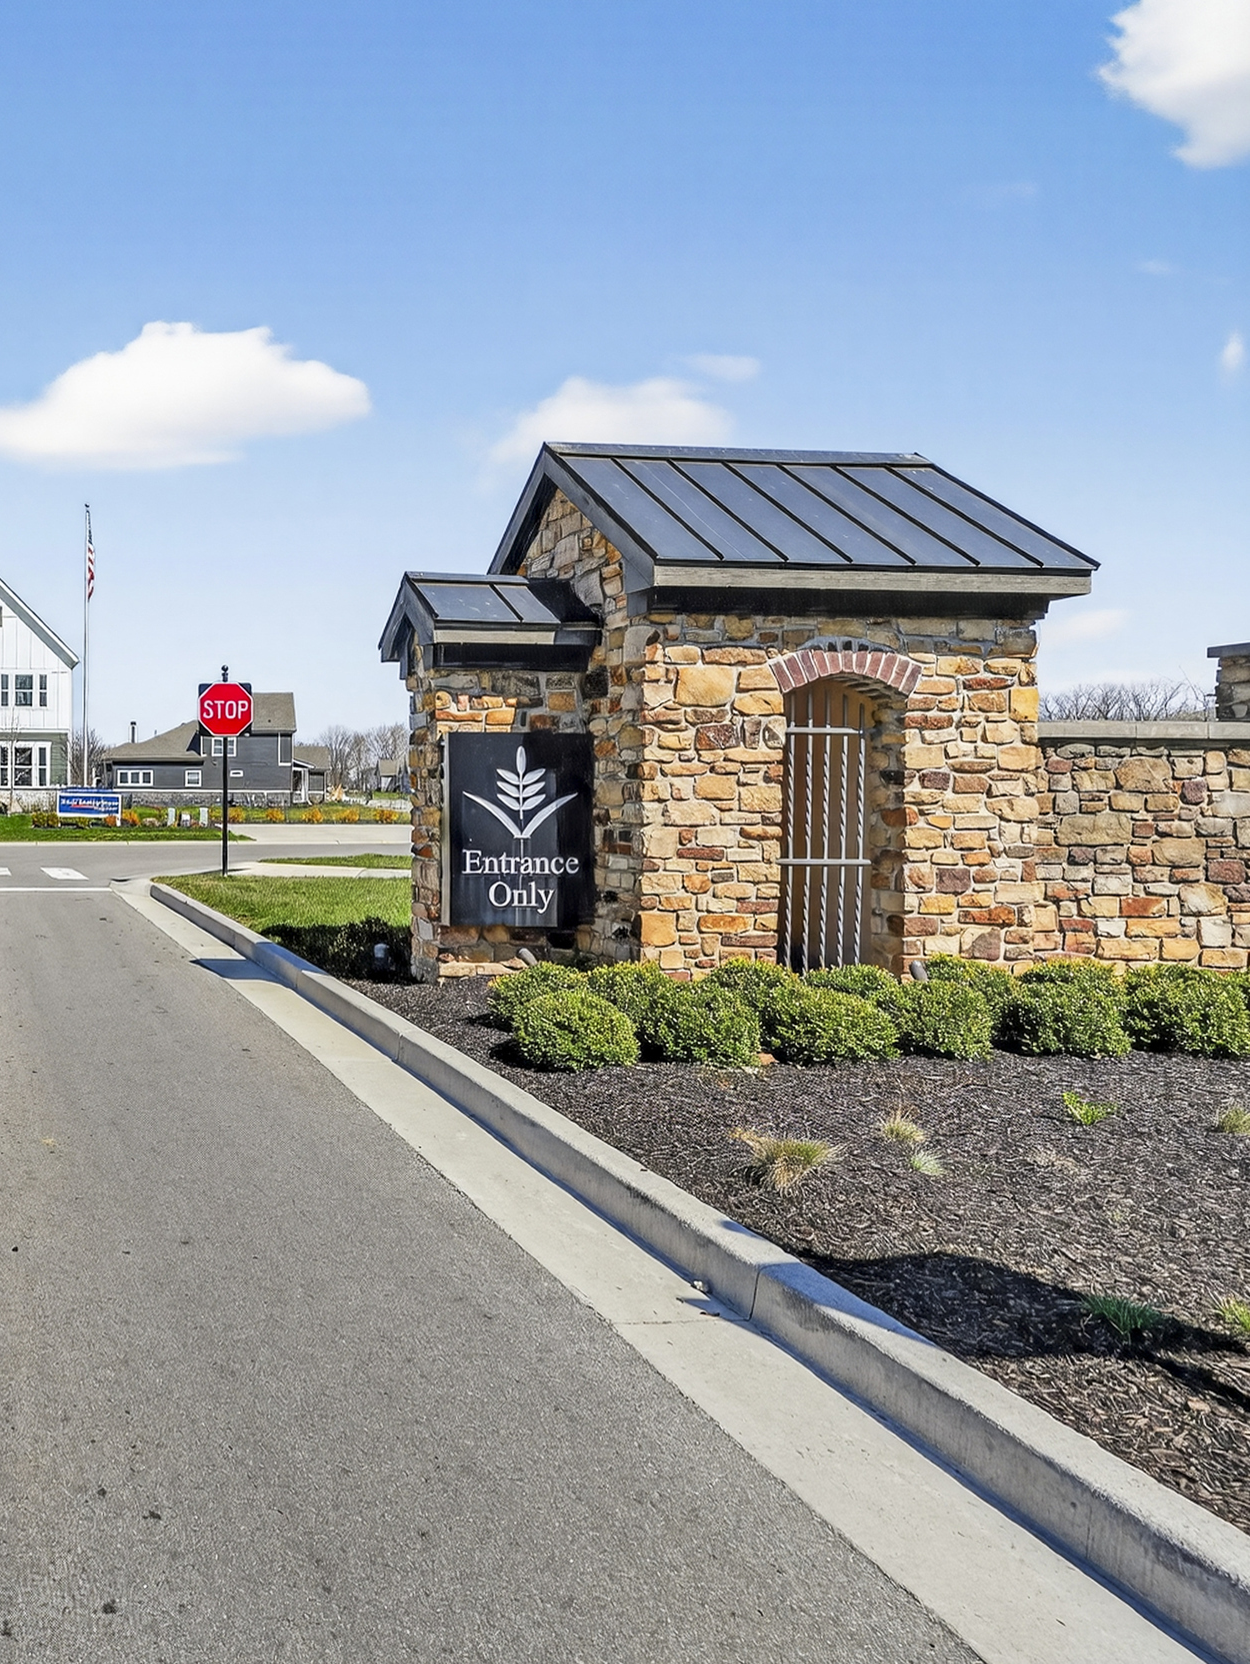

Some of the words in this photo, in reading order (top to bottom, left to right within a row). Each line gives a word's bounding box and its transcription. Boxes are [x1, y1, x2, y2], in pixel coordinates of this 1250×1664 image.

[203, 700, 249, 719] STOP
[461, 849, 580, 875] Entrance
[488, 881, 556, 914] Only
